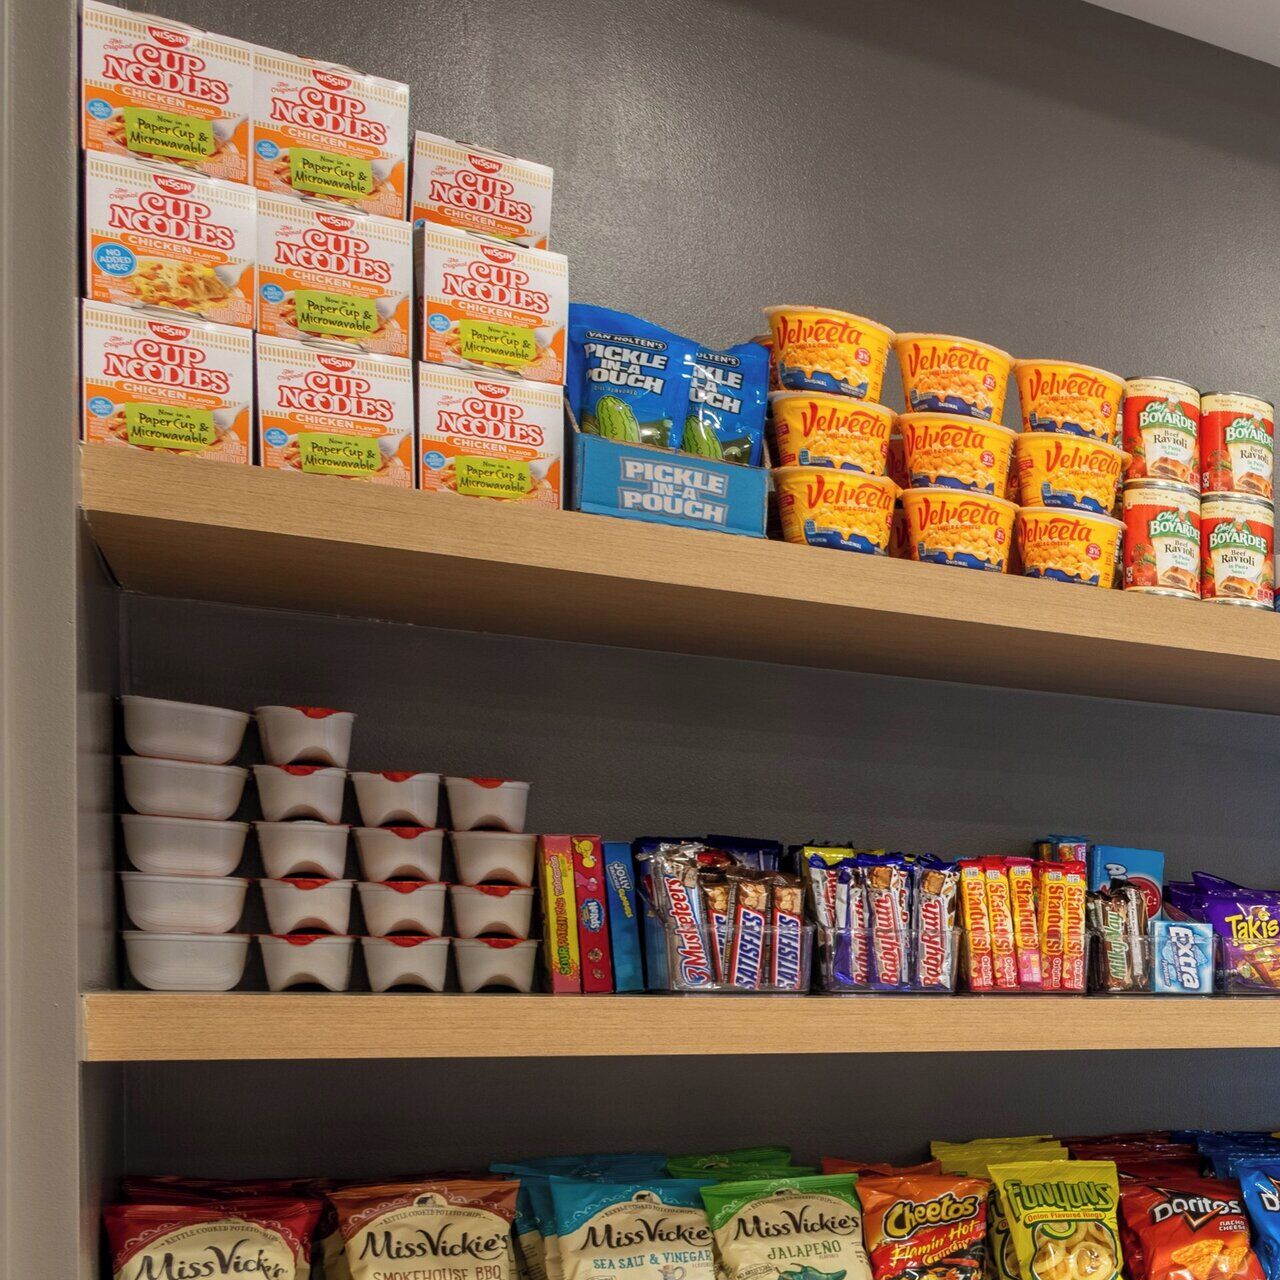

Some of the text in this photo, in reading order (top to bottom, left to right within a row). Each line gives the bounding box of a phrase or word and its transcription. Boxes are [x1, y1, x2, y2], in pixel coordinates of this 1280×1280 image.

[152, 30, 186, 44] NISSIN
[133, 43, 205, 77] CUP
[102, 54, 229, 104] NOODLES
[122, 87, 216, 115] CHICKEN FLAVOR
[138, 118, 208, 142] Paper Cup &
[130, 131, 207, 156] Microwavable
[157, 179, 192, 192] NISSIN
[138, 192, 211, 223] CUP
[109, 204, 235, 250] NOODLES
[106, 248, 121, 256] NO
[128, 236, 192, 255] CHICKEN
[100, 255, 131, 264] ADDED
[588, 332, 665, 350] VAN HOLTEN'S
[776, 315, 863, 347] Velveeta
[584, 343, 669, 371] PICKLE
[600, 359, 642, 375] IN-A
[907, 343, 990, 373] Velveeta
[478, 384, 506, 394] NISSIN
[1028, 368, 1110, 400] Velveeta
[462, 398, 523, 422] CUP
[1146, 401, 1166, 413] Chef
[437, 410, 544, 446] NOODLES
[1139, 410, 1197, 436] BOYARDEE
[1164, 430, 1179, 438] Beef
[454, 438, 508, 452] CHICKEN
[1153, 434, 1188, 449] Ravioli
[1240, 449, 1269, 465] Ravioli
[625, 461, 725, 494] PICKLE
[652, 481, 697, 500] IN-A
[623, 490, 725, 523] POUCH
[1215, 523, 1232, 534] Chef
[1210, 532, 1267, 553] BOYARDEE
[1221, 553, 1256, 566] Ravioli
[614, 862, 631, 890] JOLLY
[1225, 912, 1280, 945] Takis
[558, 946, 571, 975] SOUR
[735, 910, 764, 989] SATISFIES
[1169, 926, 1200, 989] Extra
[1004, 1180, 1115, 1222] FUNYUNS
[1153, 1196, 1243, 1224] Doritos
[734, 1205, 861, 1242] Miss Vickie's
[884, 1194, 979, 1239] Cheetos
[1027, 1210, 1103, 1220] Onion Flavored Rings
[1219, 1219, 1246, 1227] NACHO
[1219, 1223, 1248, 1232] CHEESE
[164, 1231, 193, 1246] KETTLE
[195, 1226, 225, 1237] COOKED
[360, 1223, 511, 1261] Miss Vickie's
[580, 1225, 645, 1252] Miss
[890, 1219, 975, 1267] Flamin' Hot
[593, 1249, 713, 1270] SEA SALT & VINEGAR
[767, 1239, 843, 1260] JALAPEÑO
